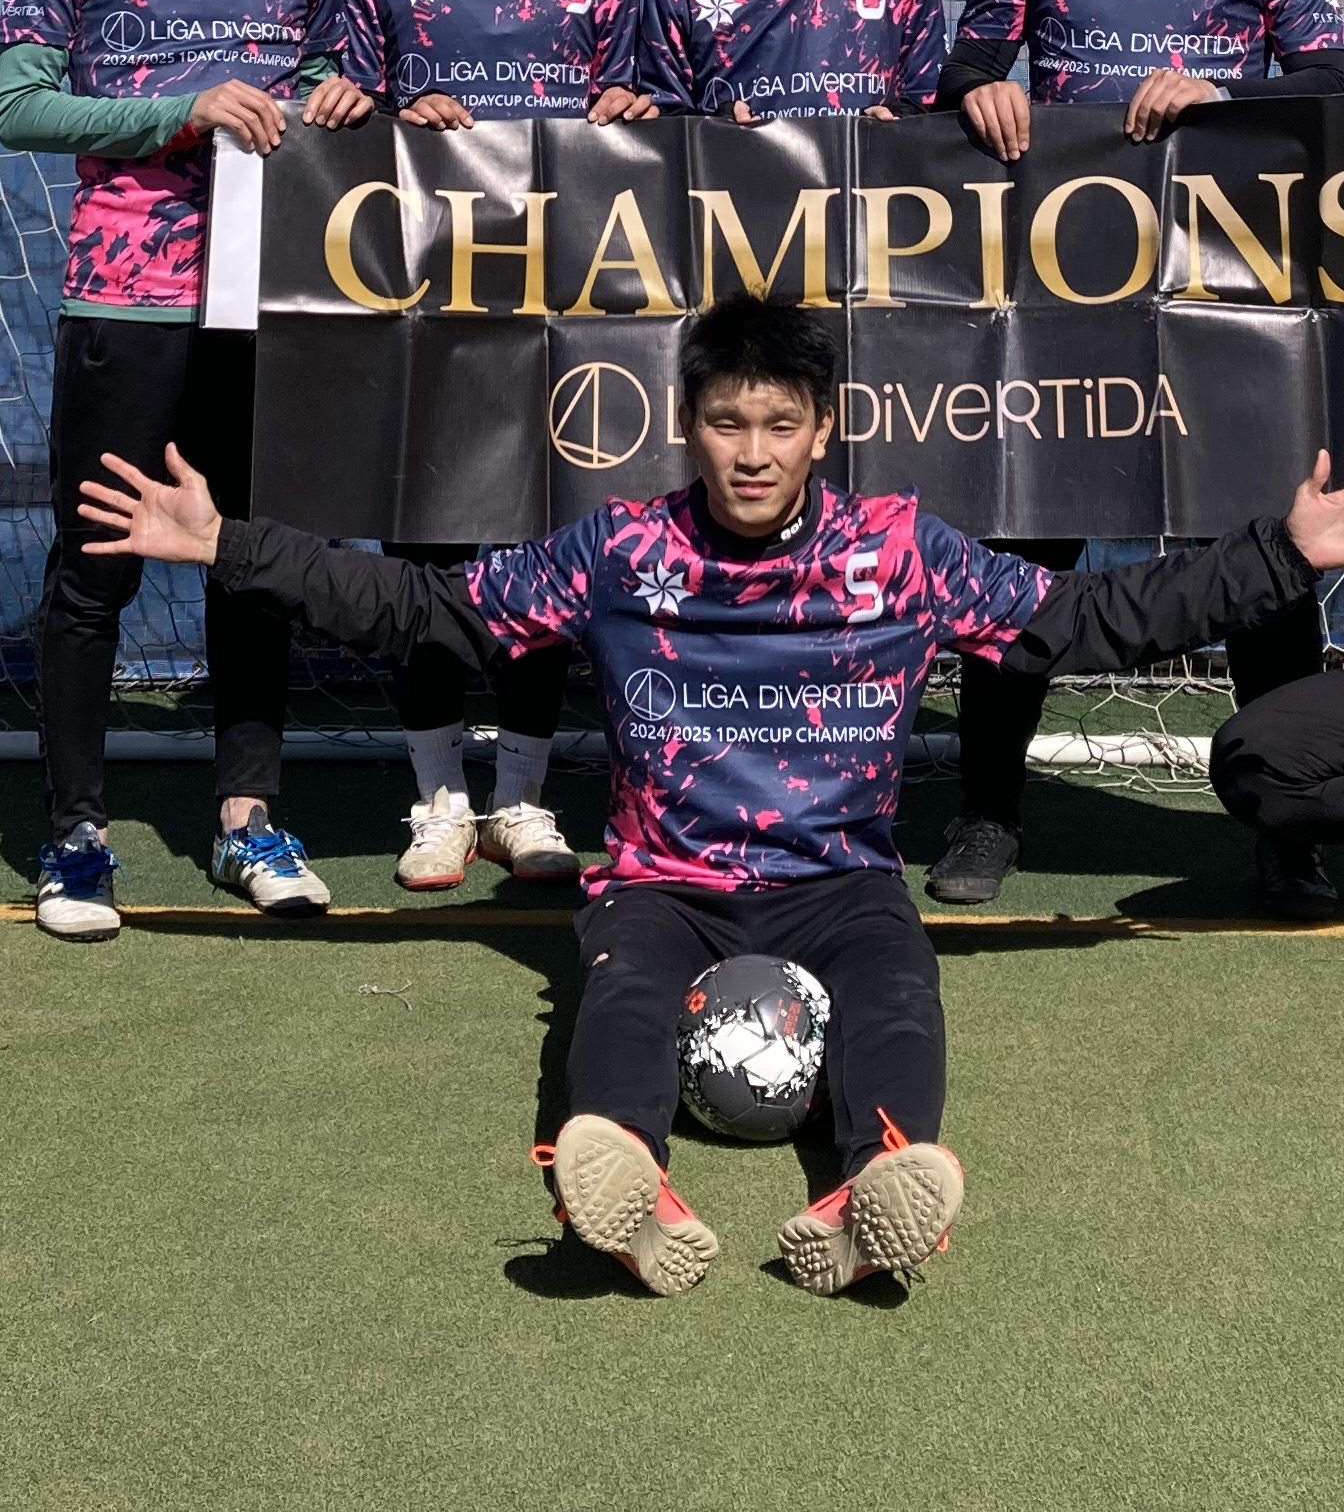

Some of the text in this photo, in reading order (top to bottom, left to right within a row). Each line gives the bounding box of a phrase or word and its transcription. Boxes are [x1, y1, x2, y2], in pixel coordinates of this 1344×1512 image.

[102, 52, 175, 66] 2024/2025
[240, 51, 299, 68] CHAMPION
[1038, 57, 1091, 74] 2024/2025
[1161, 66, 1243, 80] AMPIONS
[845, 551, 883, 624] 5
[629, 723, 895, 743] 2024/2025 1DAYCUP CHAMPIONS
